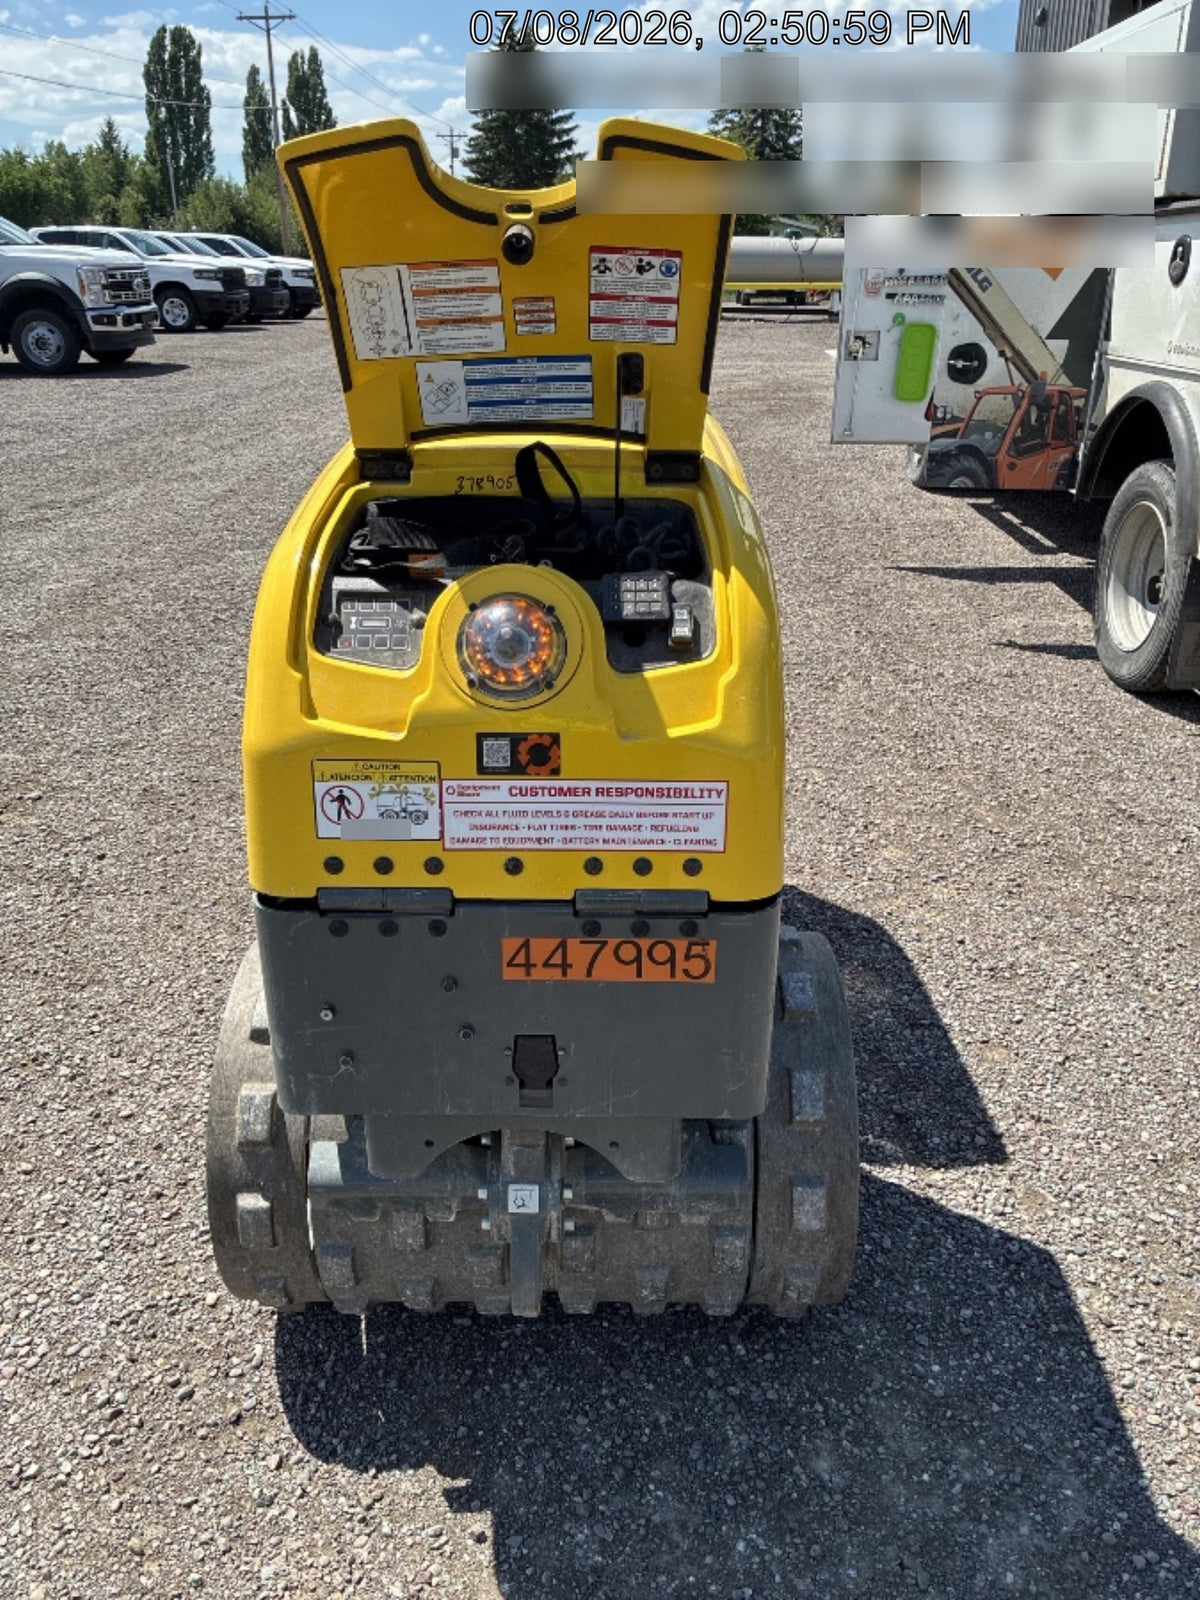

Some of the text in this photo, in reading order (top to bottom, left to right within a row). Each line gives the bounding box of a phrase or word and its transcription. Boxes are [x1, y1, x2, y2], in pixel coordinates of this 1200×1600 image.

[361, 762, 401, 771] CAUTION
[508, 786, 724, 799] CUSTOMER RESPONSIBILITY
[453, 810, 482, 818] CHECK
[485, 810, 499, 818] ALL
[502, 810, 529, 818] FLUID
[531, 810, 562, 818] LEVELS
[572, 810, 607, 818] GREASE
[608, 810, 634, 818] DAILY
[450, 837, 488, 845] DAMAGE
[489, 837, 500, 845] TO
[502, 837, 556, 845] EQUIPMENT
[561, 837, 600, 845] BATTERY
[506, 937, 712, 980] 447995
